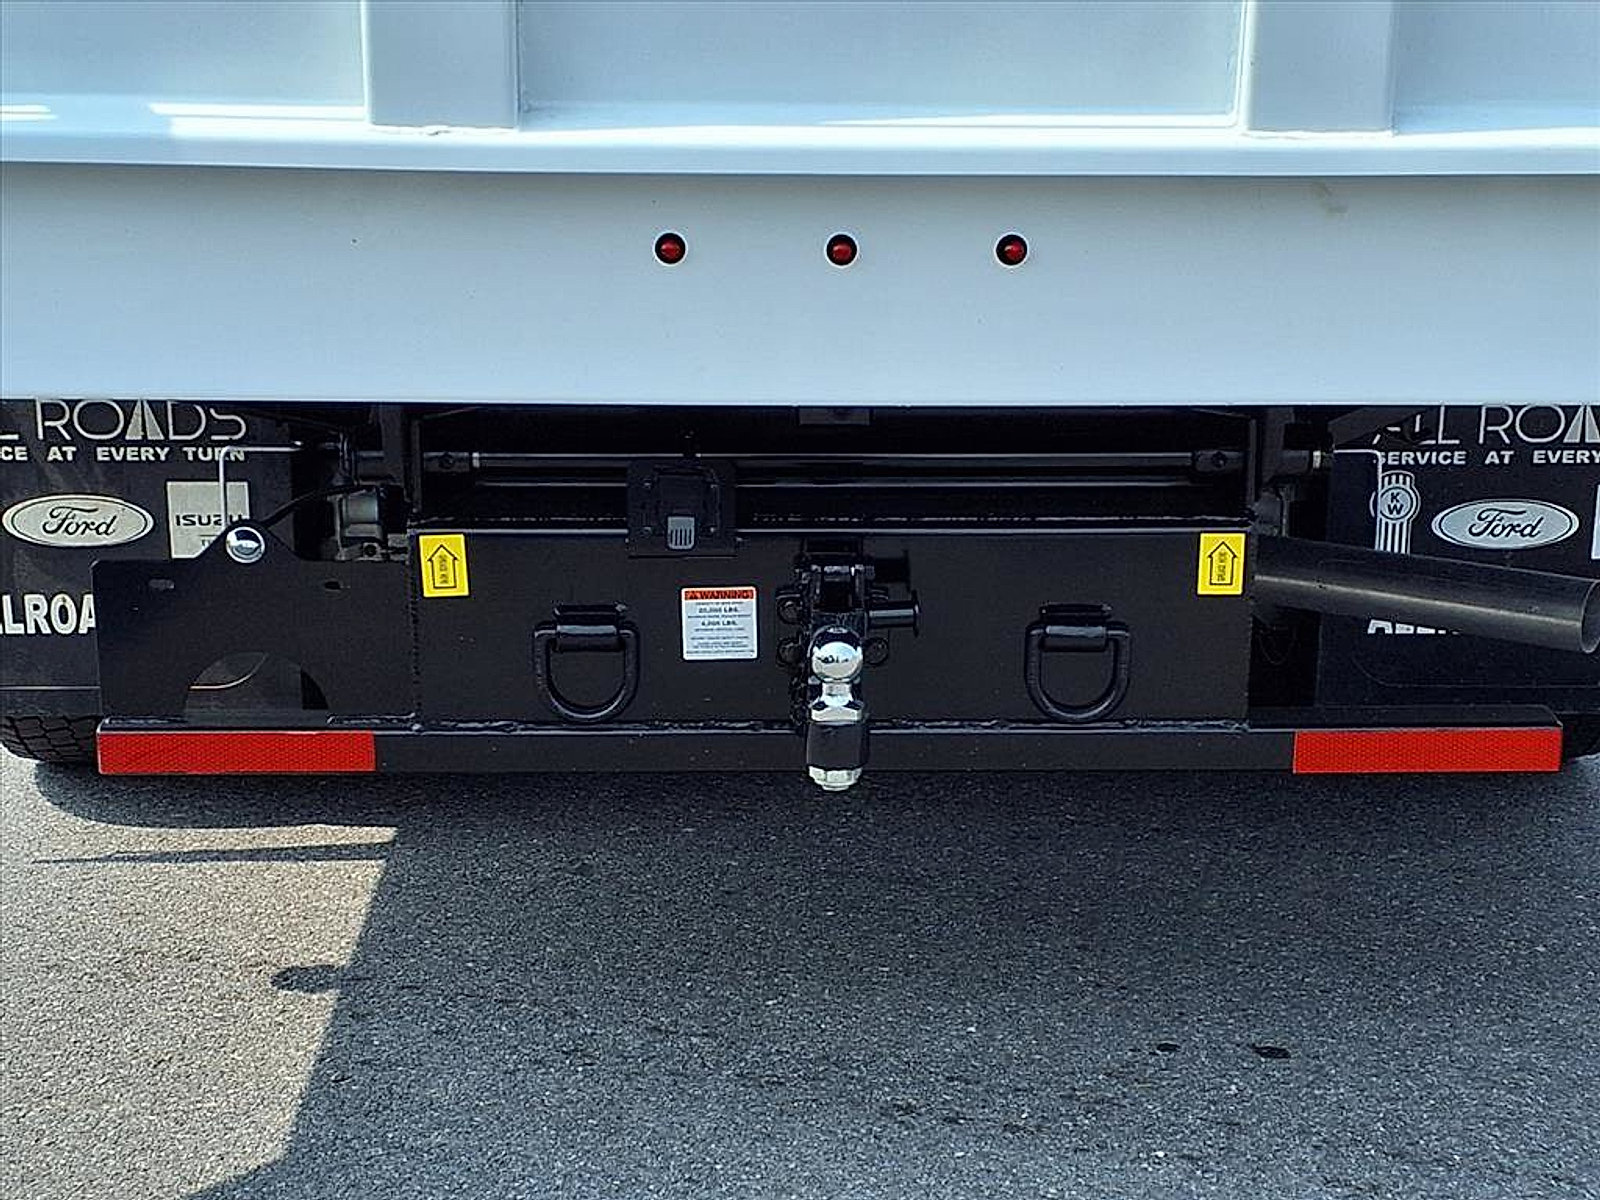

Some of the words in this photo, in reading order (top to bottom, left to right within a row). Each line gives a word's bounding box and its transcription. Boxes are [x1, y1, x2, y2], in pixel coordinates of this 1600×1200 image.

[35, 399, 247, 440] ROADS
[46, 446, 77, 461] AT
[96, 446, 170, 461] EVERY
[1373, 450, 1467, 465] SERVICE
[1484, 450, 1515, 465] AT
[1532, 449, 1600, 464] EVERY
[41, 505, 118, 537] Ford
[175, 513, 243, 527] ISUZU
[1467, 507, 1545, 538] Ford
[700, 589, 750, 600] WARNING
[0, 593, 96, 634] LROA
